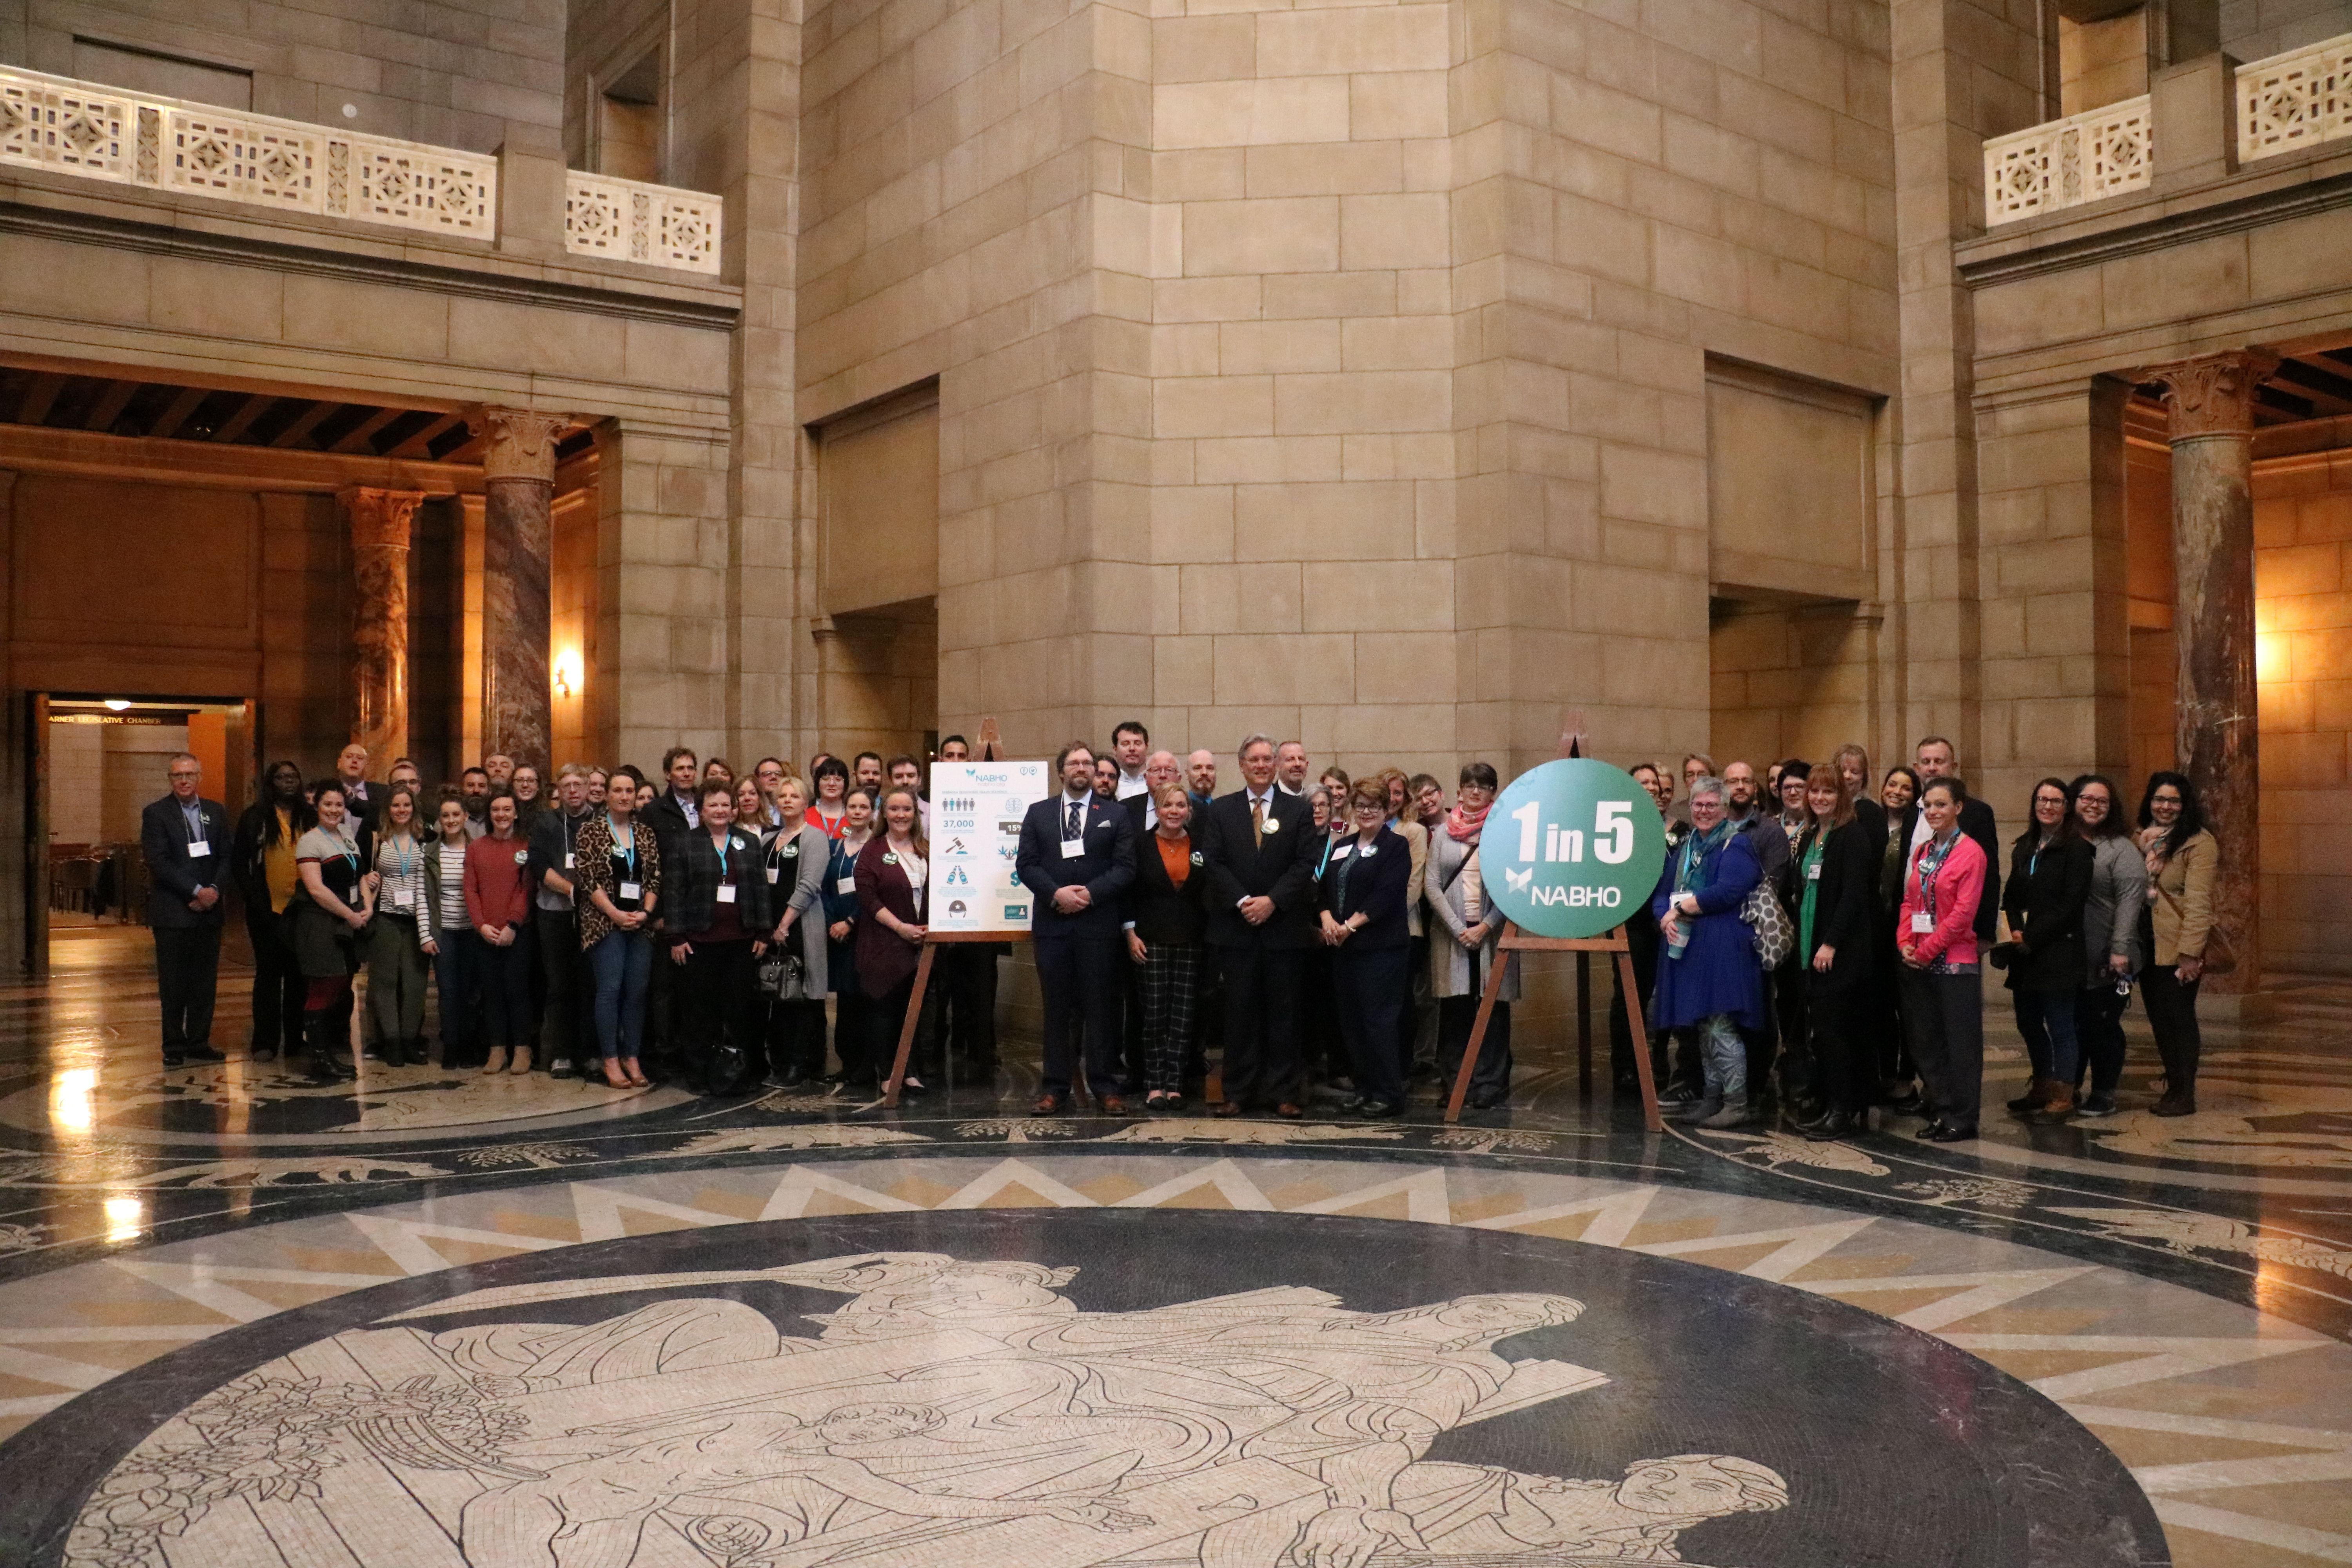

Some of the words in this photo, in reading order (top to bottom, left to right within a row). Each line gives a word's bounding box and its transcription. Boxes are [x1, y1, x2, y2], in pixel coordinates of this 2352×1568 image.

[943, 820, 974, 828] 37,000
[1512, 801, 1539, 862] 1
[1545, 824, 1583, 862] in
[1594, 801, 1633, 864] 5
[1531, 886, 1621, 907] NABHO
